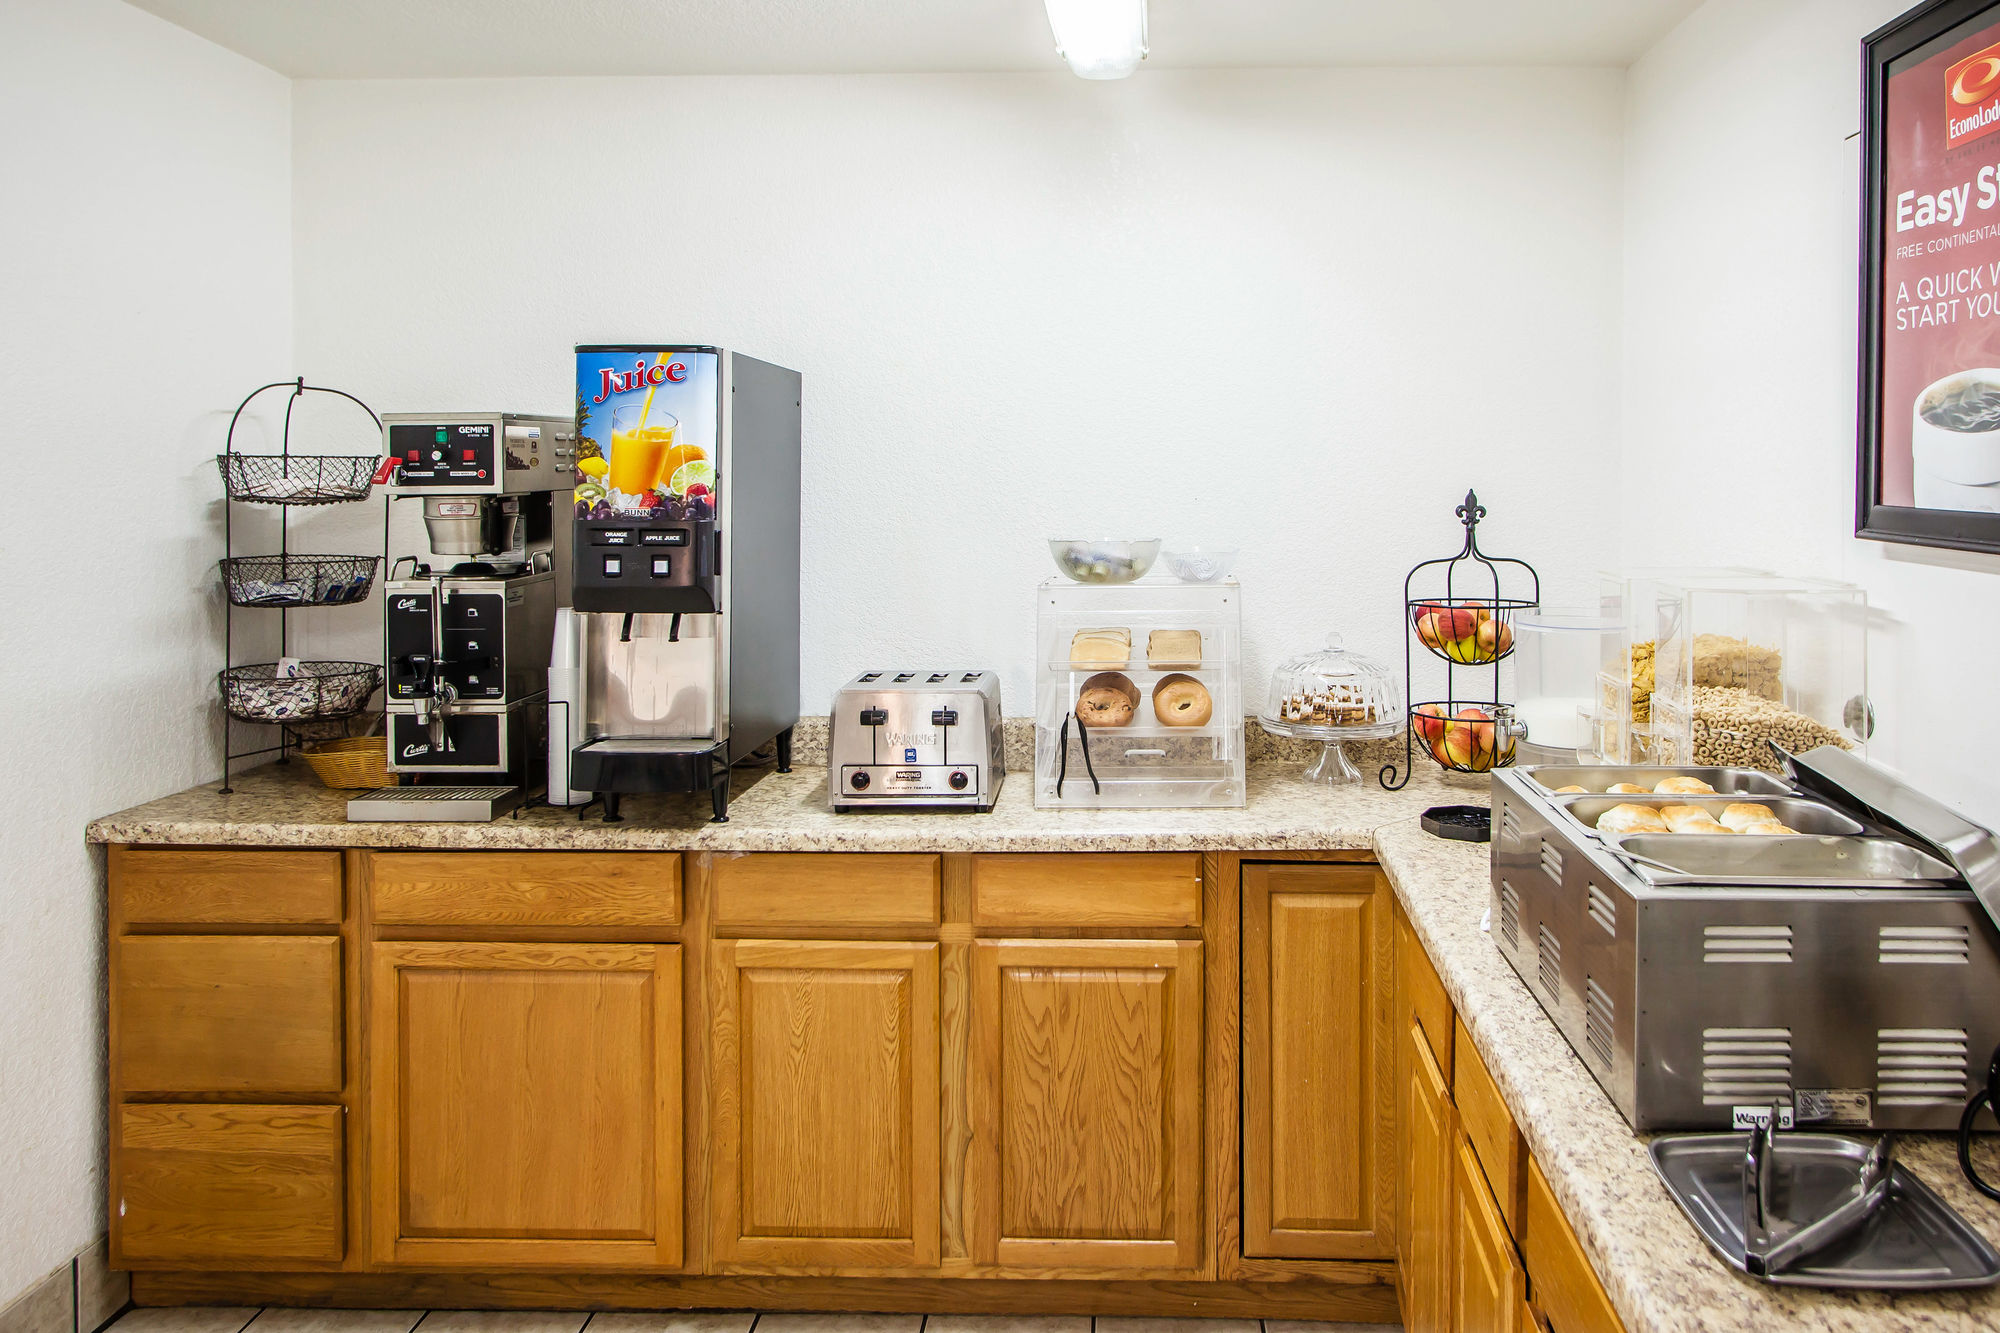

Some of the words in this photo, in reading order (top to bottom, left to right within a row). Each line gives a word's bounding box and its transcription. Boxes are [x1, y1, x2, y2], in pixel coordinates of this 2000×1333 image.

[1950, 99, 2000, 139] EconoLod
[1897, 182, 1971, 232] Easy
[1897, 243, 1923, 260] FREE
[1896, 281, 1909, 304] A
[1917, 265, 1982, 300] QUICK
[1896, 298, 1960, 330] START
[593, 360, 687, 404] Juice
[458, 426, 489, 434] GEMINI
[624, 509, 650, 517] BUNN
[884, 732, 937, 748] WARING
